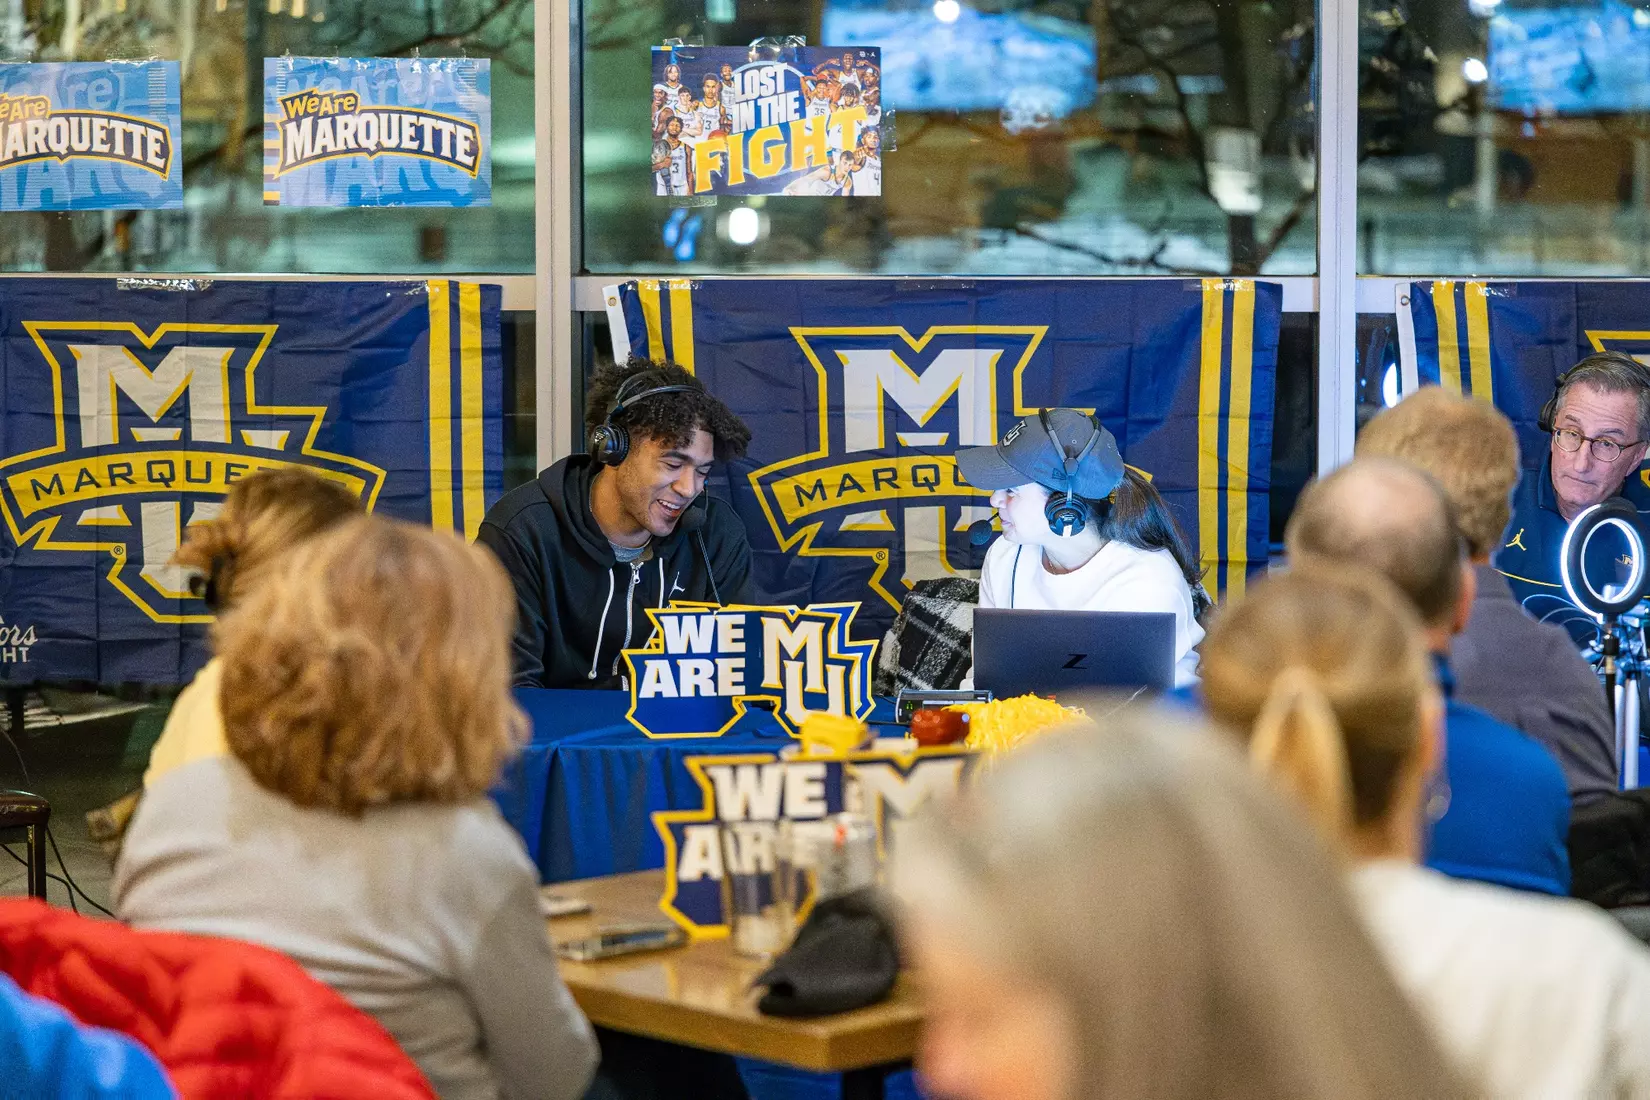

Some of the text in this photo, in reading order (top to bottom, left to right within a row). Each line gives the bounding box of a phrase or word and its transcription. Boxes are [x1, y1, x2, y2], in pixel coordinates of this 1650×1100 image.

[734, 63, 788, 102] LOST
[732, 90, 800, 134] IN THE
[0, 116, 166, 169] ARQUETTE
[284, 112, 476, 166] MARQUETTE
[694, 105, 867, 193] FIGHT
[30, 460, 262, 501] MARQUE
[660, 614, 746, 654] WE
[639, 657, 746, 698] ARE
[707, 763, 827, 820] WE
